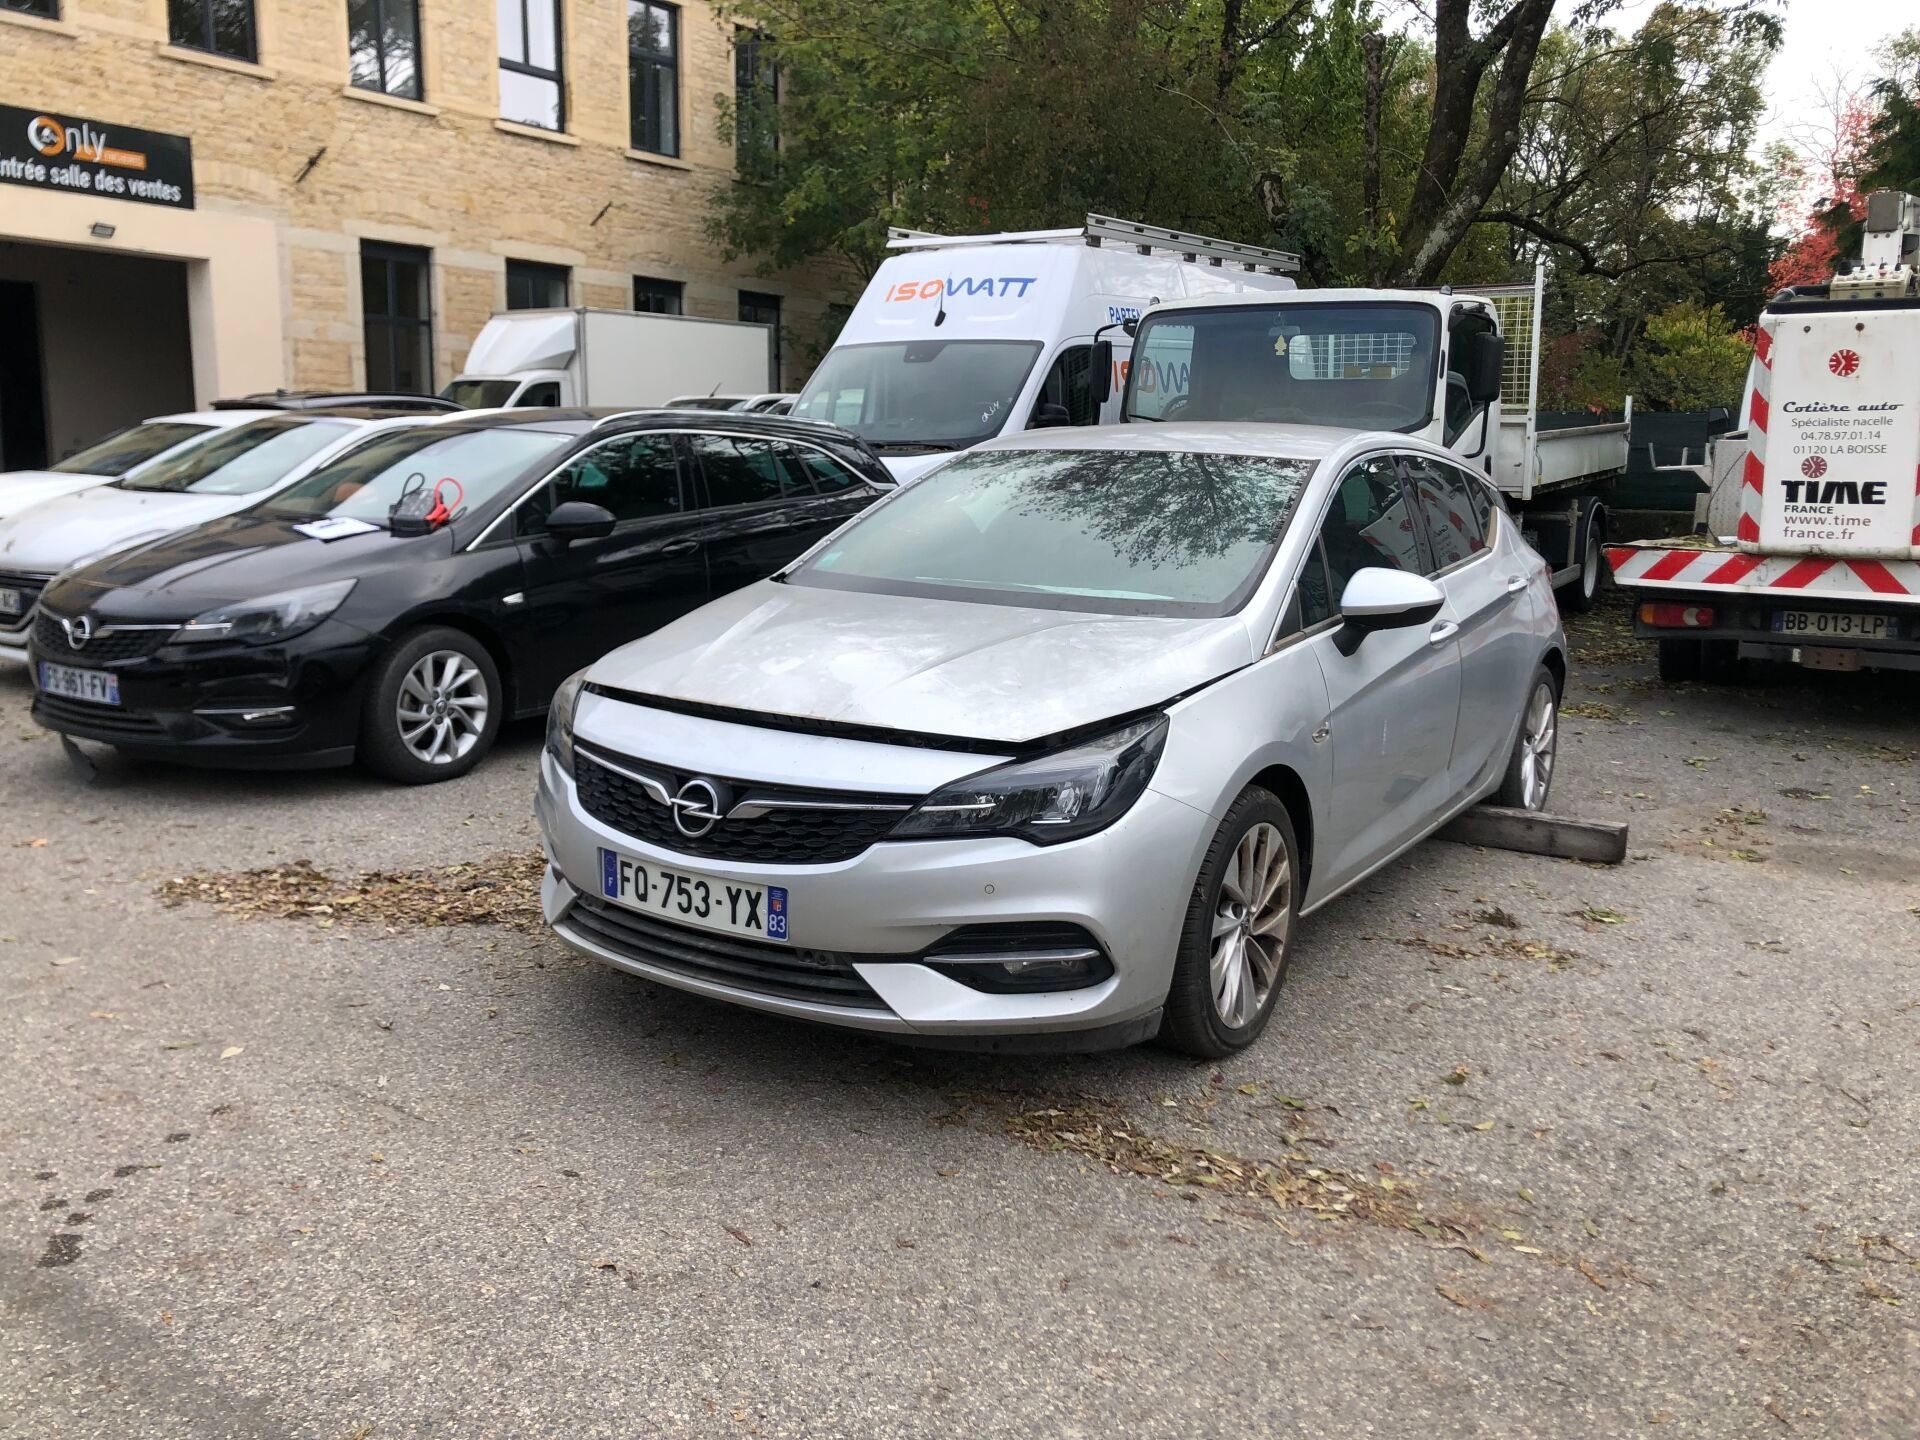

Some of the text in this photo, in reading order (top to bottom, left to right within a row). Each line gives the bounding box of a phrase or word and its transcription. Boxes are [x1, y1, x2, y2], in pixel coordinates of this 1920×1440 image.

[28, 116, 106, 162] Only
[0, 157, 182, 202] ntrée salle des ventes
[886, 276, 1037, 302] ISOWATT
[1783, 401, 1903, 413] Cotière auto
[1791, 416, 1893, 428] Spécialiste nacelle
[1801, 430, 1881, 441] 04.78.97.01.14
[1793, 444, 1887, 455] 01120 LA BOISSE
[1781, 480, 1887, 505] TIME
[1784, 504, 1834, 515] FRANCE
[1784, 515, 1871, 527] www.time
[1784, 526, 1855, 540] france.fr
[1784, 613, 1885, 635] BB-013-LP
[620, 860, 763, 930] FQ-753-YX
[769, 914, 785, 933] 83
